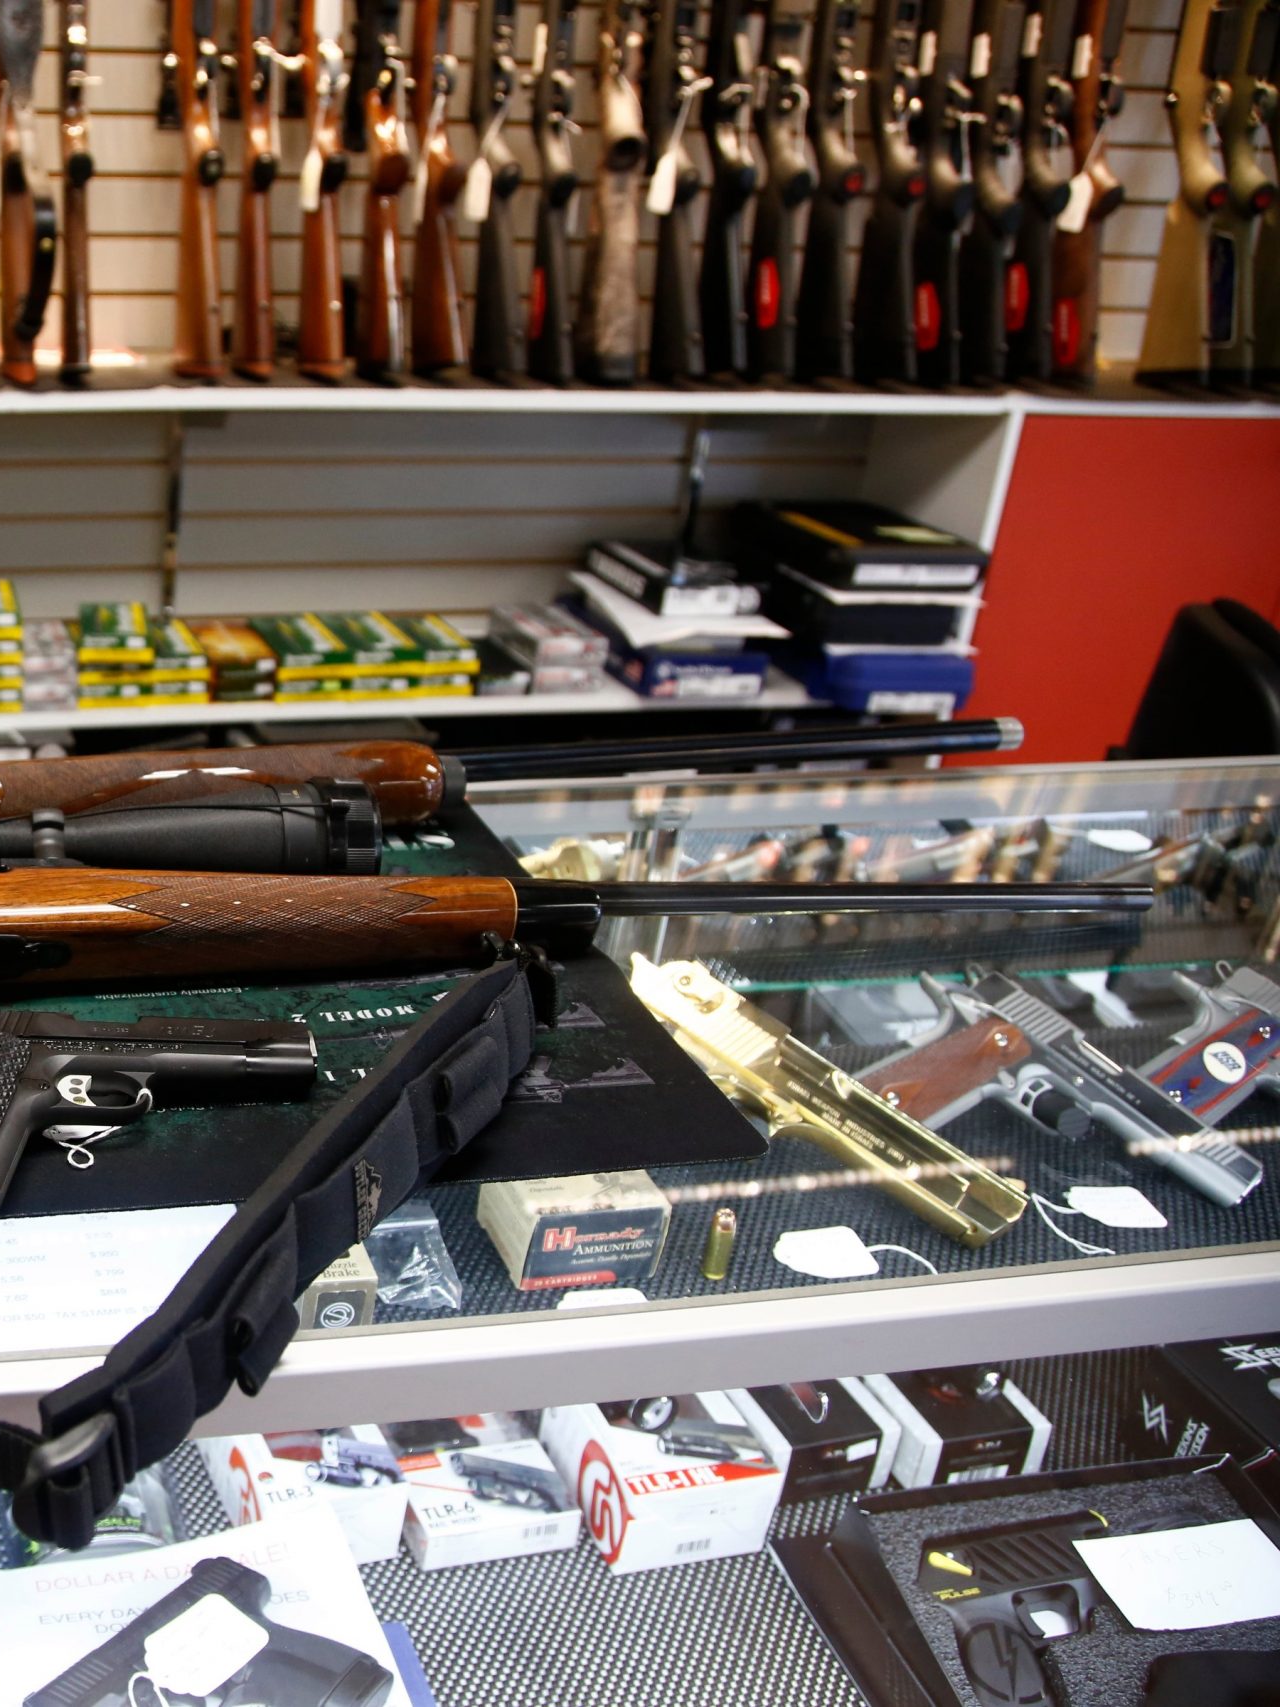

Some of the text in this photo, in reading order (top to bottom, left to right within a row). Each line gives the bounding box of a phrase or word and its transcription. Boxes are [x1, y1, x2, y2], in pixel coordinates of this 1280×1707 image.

[180, 986, 243, 996] Extremely
[291, 1004, 417, 1023] MODEL 2
[812, 1096, 841, 1119] WEAPON
[845, 1119, 886, 1150] INDUSTRIES
[542, 1226, 646, 1252] Hornady
[572, 1240, 655, 1256] AMMUNITION
[322, 1268, 360, 1279] Brake
[328, 1261, 358, 1270] uzzle
[546, 1274, 598, 1286] CARTRIDGES
[56, 1311, 78, 1320] TAX
[81, 1309, 121, 1318] STAMP
[266, 1485, 314, 1504] TLR-3
[422, 1501, 475, 1521] TLR-6
[34, 1541, 289, 1593] DOLLAR A DA ALE!
[940, 1587, 982, 1600] PULSE
[38, 1610, 105, 1626] EVERY
[270, 1590, 310, 1605] OES
